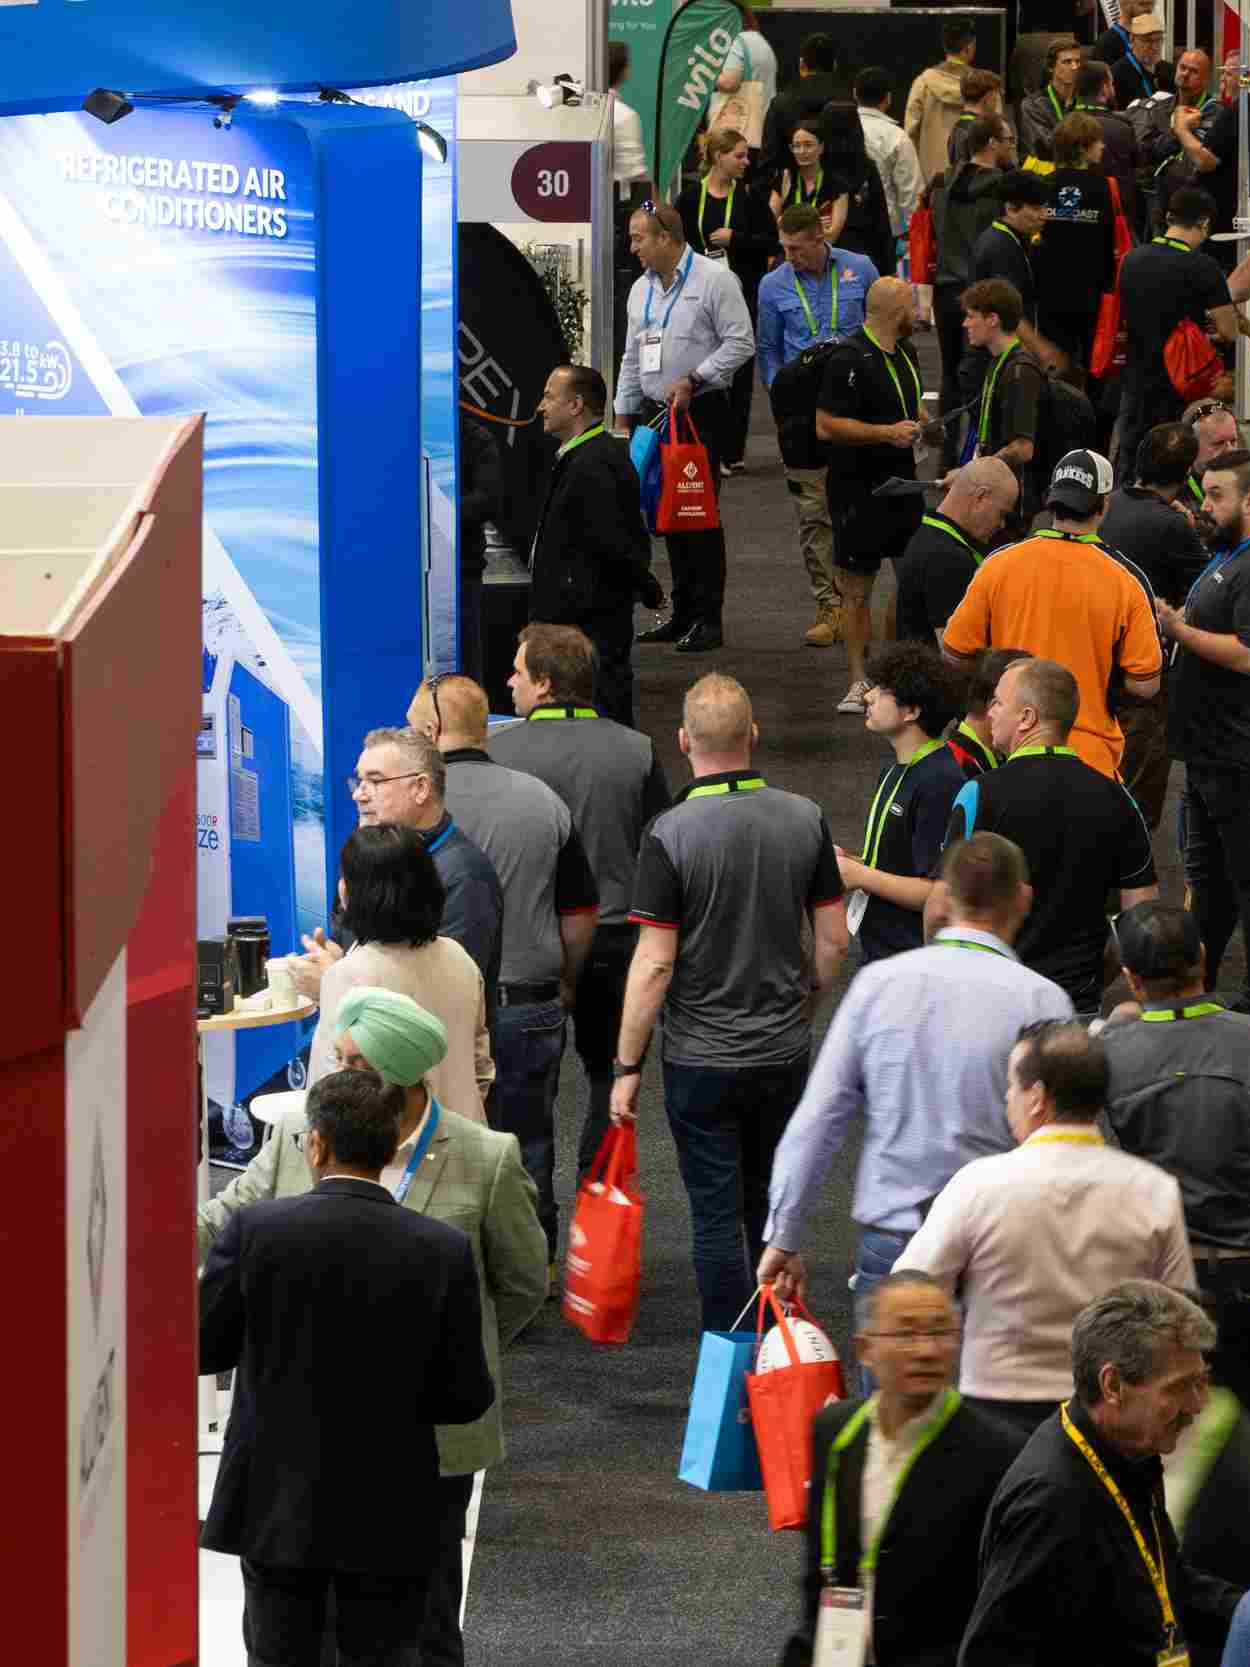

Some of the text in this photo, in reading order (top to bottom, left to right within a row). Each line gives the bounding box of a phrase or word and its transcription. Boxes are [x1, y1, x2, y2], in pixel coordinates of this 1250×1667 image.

[677, 27, 733, 110] wilo
[62, 151, 288, 201] REFRIGERATED AIR
[536, 169, 570, 197] 30
[100, 190, 288, 240] CONDITIONERS
